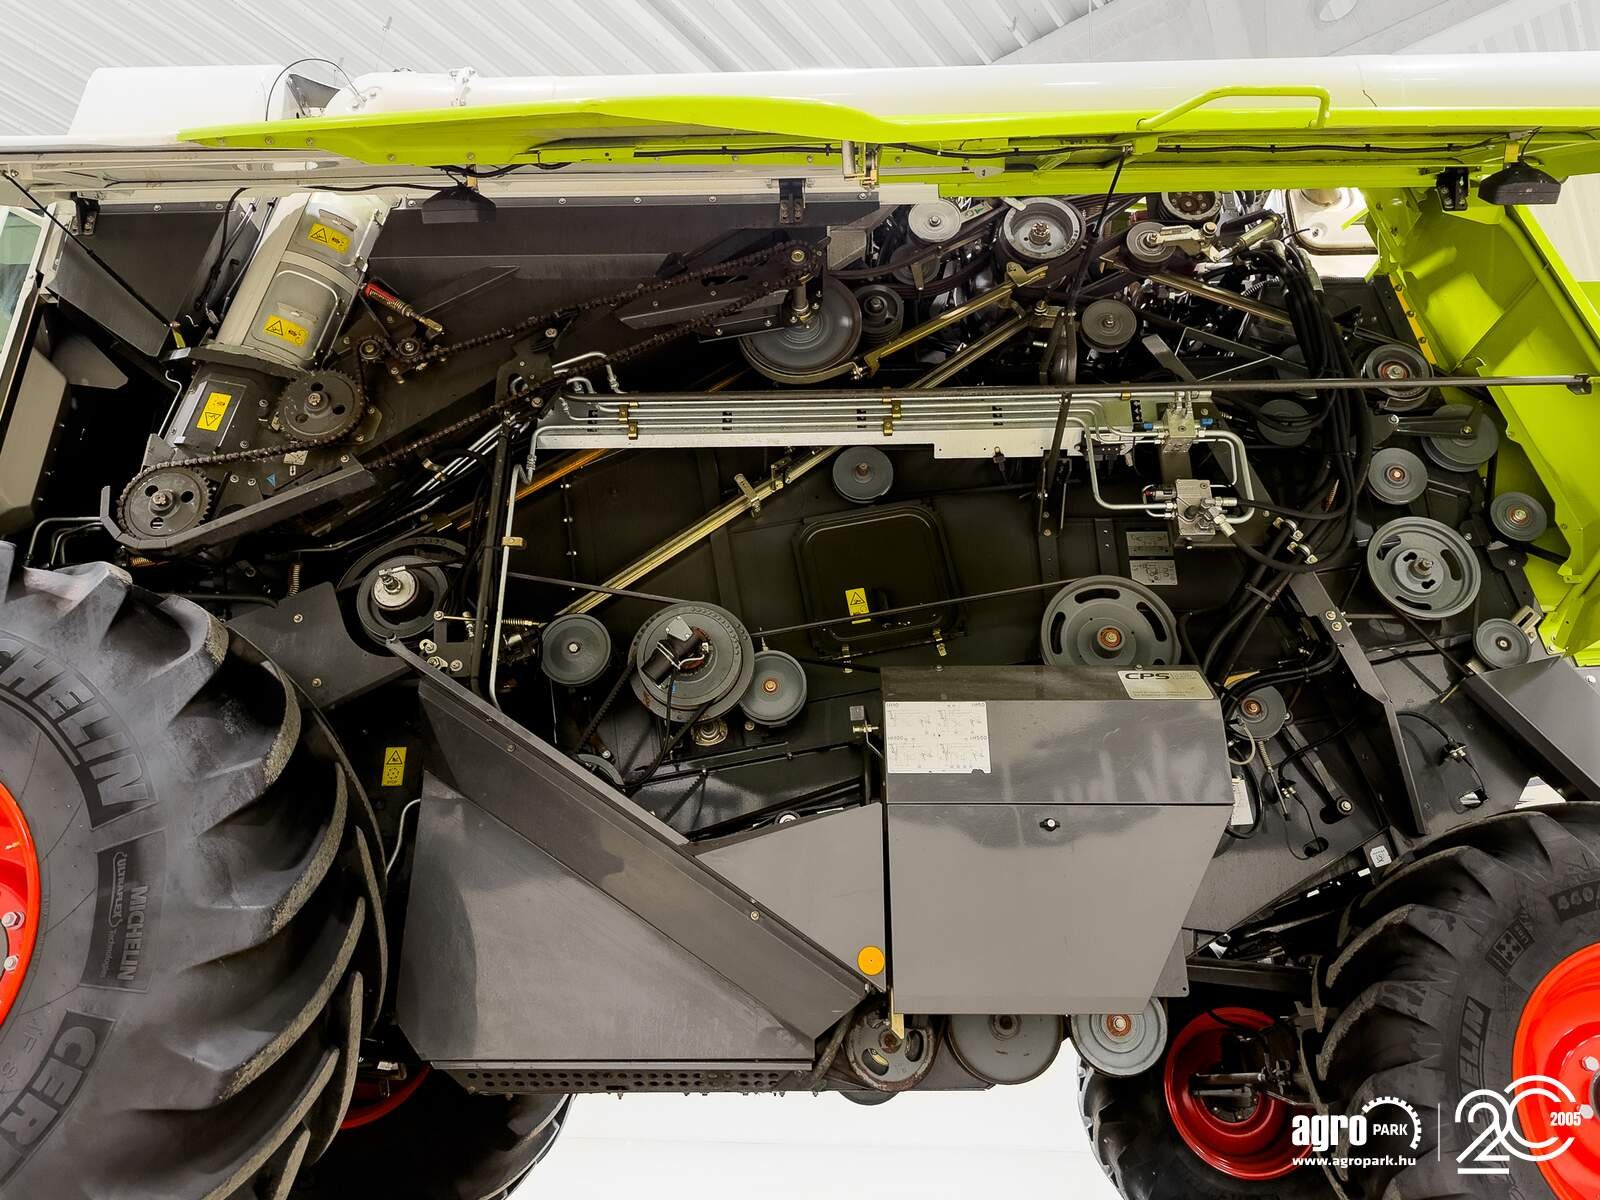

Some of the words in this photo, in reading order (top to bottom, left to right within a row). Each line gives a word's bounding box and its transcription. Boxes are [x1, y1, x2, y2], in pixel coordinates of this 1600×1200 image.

[1124, 672, 1170, 680] CPS
[111, 858, 127, 919] ULTRAFLEX
[117, 885, 149, 981] MICHELIN
